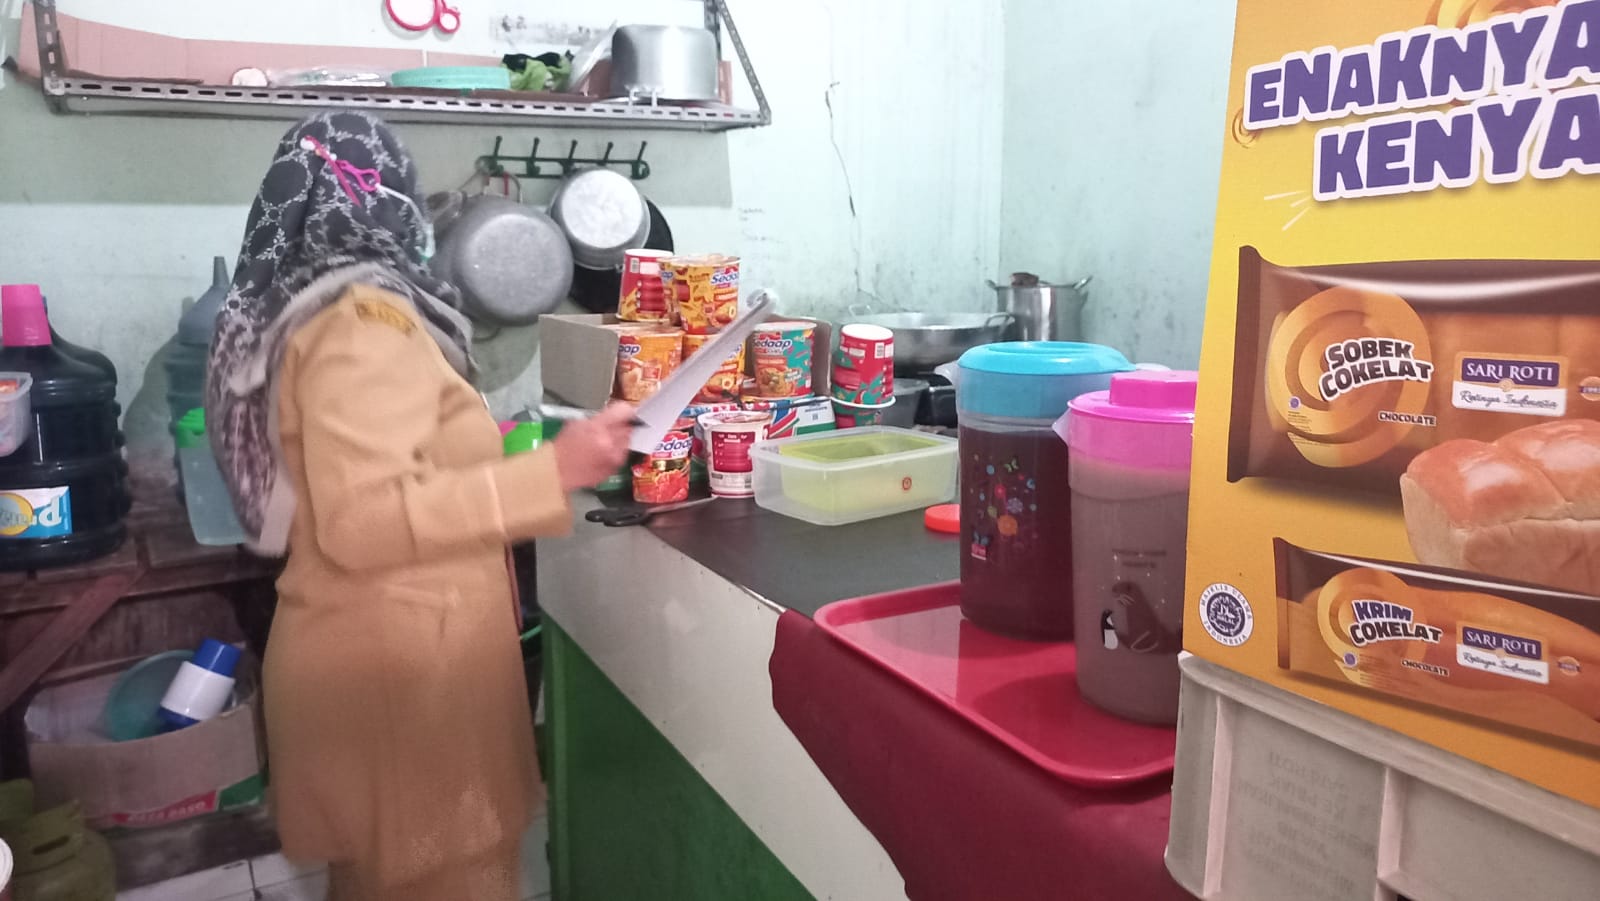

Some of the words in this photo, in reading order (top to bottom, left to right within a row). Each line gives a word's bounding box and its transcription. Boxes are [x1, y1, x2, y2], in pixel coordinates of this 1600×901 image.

[1247, 0, 1600, 124] ENAKNYA
[1318, 93, 1600, 194] KENYA
[1327, 339, 1413, 371] SOBEK
[1320, 359, 1433, 399] COKELAT
[1466, 362, 1503, 379] SARI
[1509, 365, 1554, 382] ROTI
[1379, 411, 1436, 426] CHOCOLATE
[1354, 600, 1412, 622] KRIM
[1350, 621, 1442, 645] COKELAT
[1465, 630, 1497, 649] SARI
[1501, 637, 1538, 656] ROTI
[1401, 659, 1450, 677] CHOCOLATE
